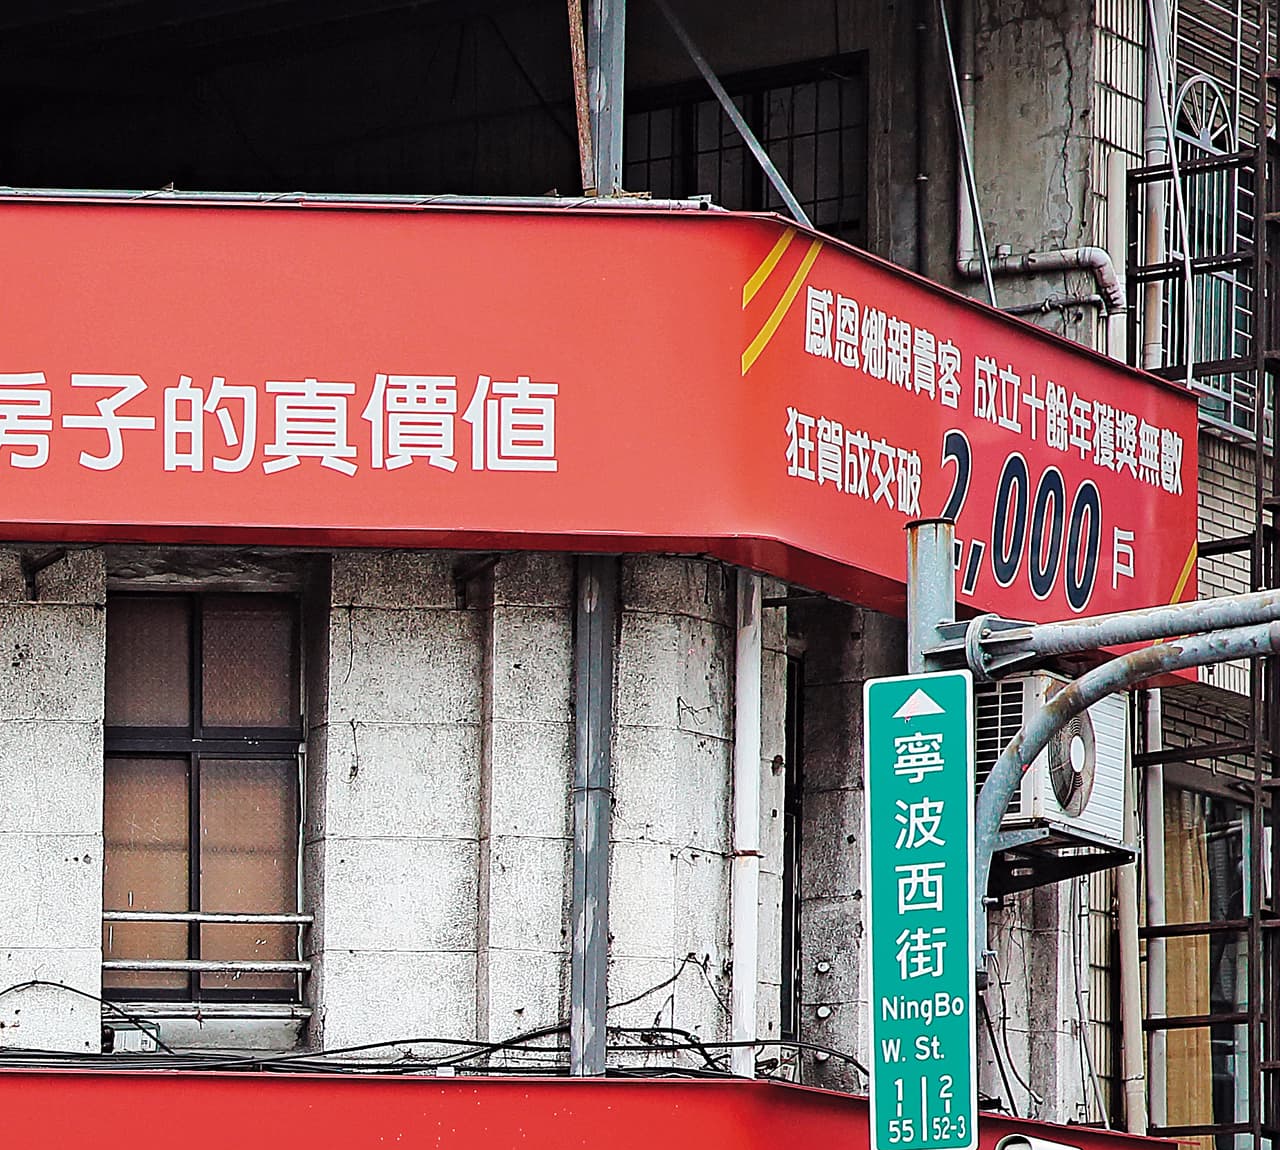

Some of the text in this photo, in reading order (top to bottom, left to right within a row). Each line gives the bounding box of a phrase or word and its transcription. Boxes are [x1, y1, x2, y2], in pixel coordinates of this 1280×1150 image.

[804, 284, 1184, 496] 感恩鄉親貴客 成立十餘年獲獎無數
[784, 406, 922, 519] 狂賀成交破
[940, 428, 1102, 615] 2,000
[892, 731, 946, 982] 寧波西街
[882, 992, 965, 1026] NingBo
[882, 1036, 945, 1064] W. St.
[888, 1115, 966, 1143] 55 52-3
